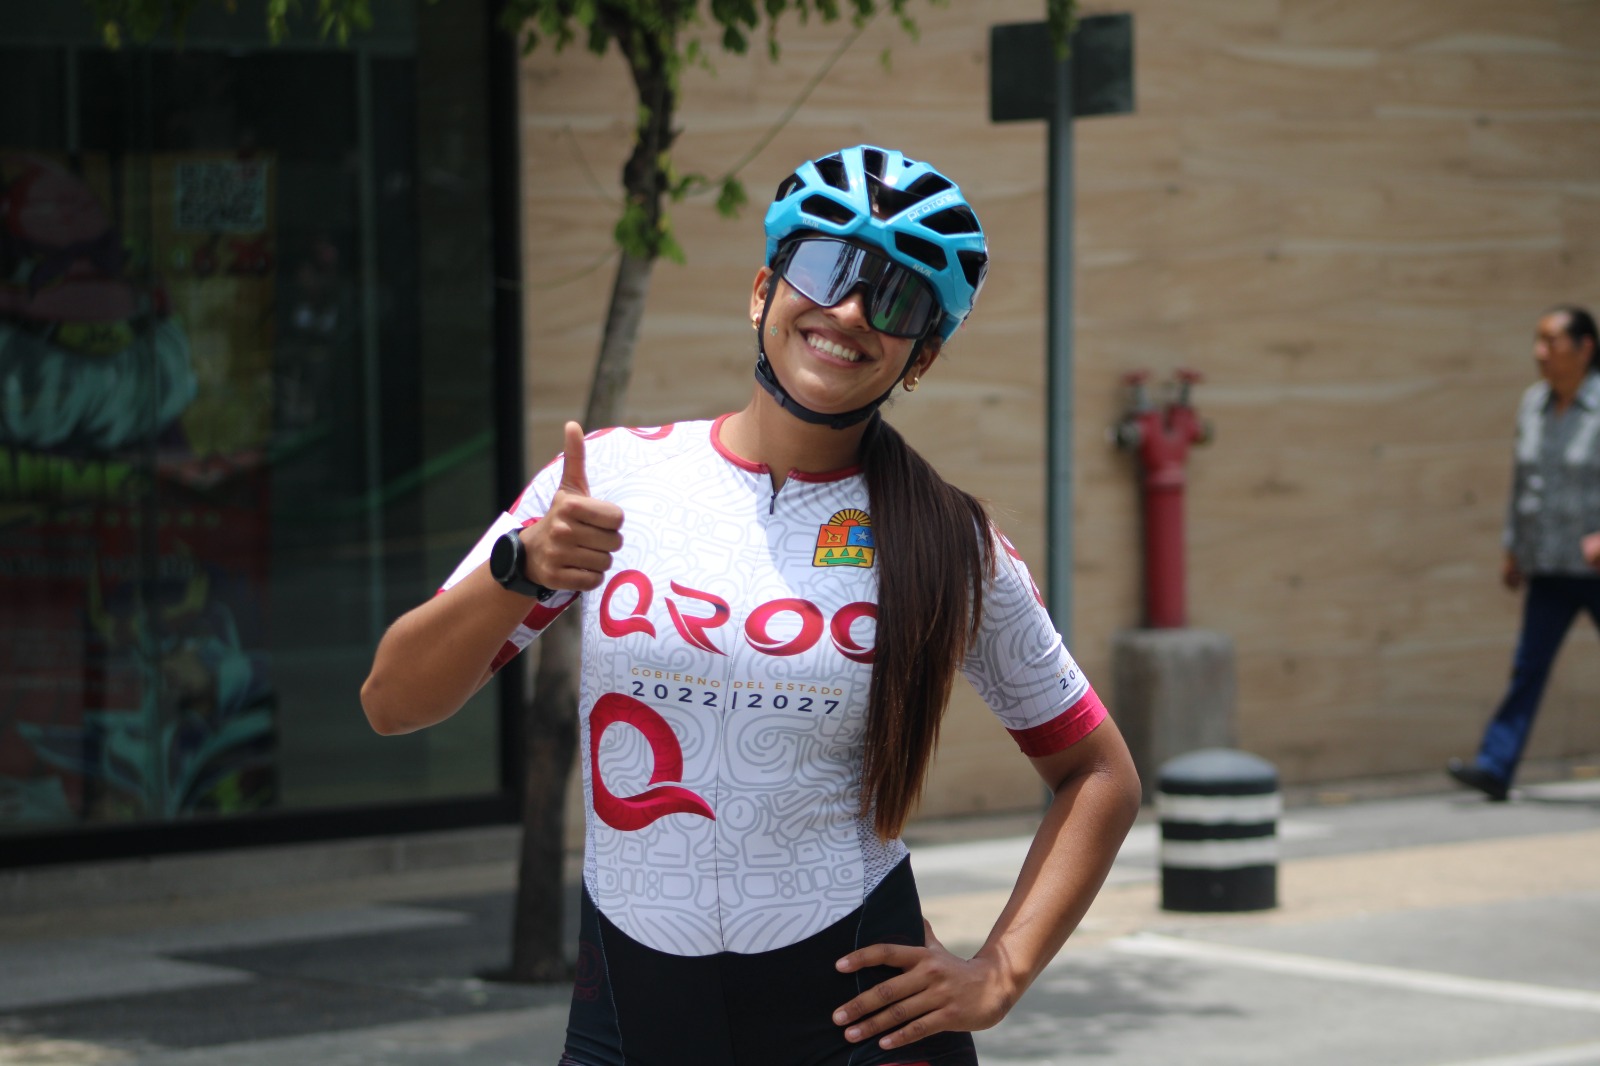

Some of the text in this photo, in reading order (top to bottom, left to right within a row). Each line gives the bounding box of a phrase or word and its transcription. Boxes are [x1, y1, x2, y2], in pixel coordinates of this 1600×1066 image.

[631, 667, 843, 696] GOBIERNO DEL ESTADO
